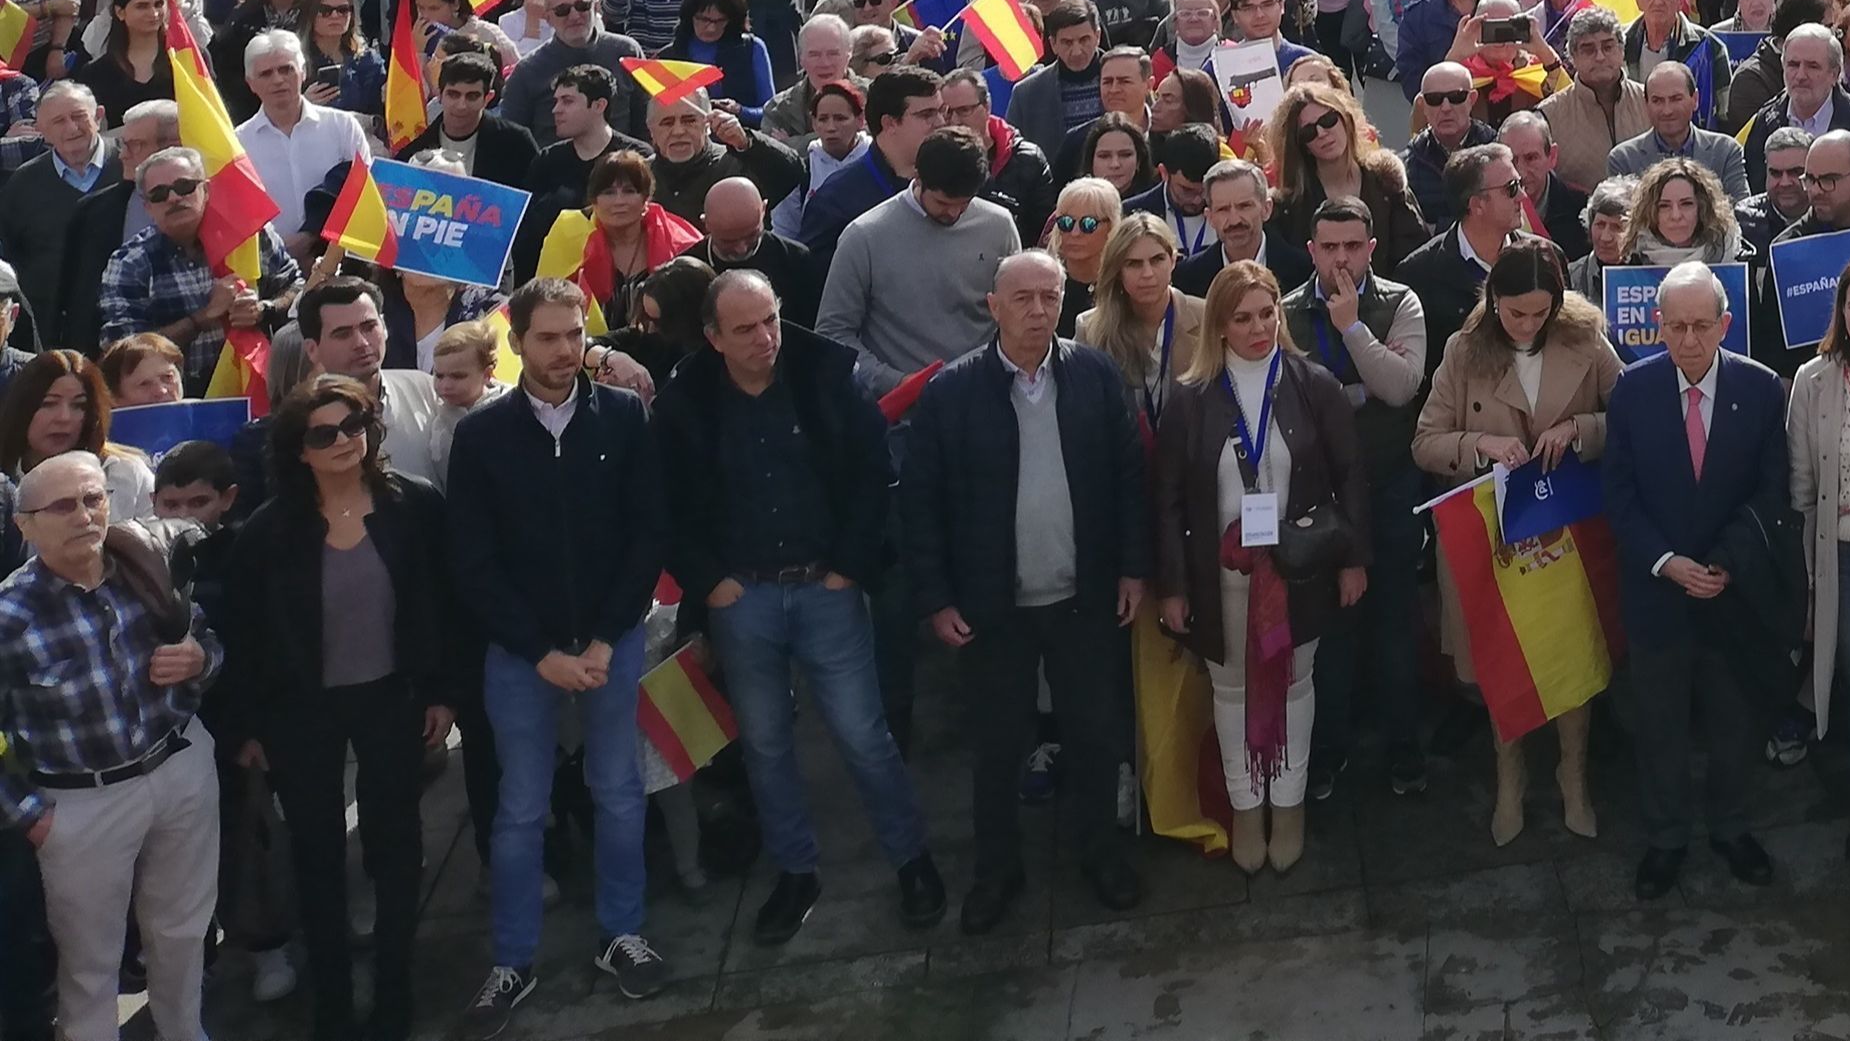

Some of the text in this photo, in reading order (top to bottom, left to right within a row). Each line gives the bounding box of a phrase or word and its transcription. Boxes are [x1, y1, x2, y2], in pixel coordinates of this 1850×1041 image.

[413, 215, 468, 248] PIE
[1617, 285, 1660, 304] ESP
[1786, 275, 1840, 298] #ESPAÑA
[1617, 307, 1645, 324] EN
